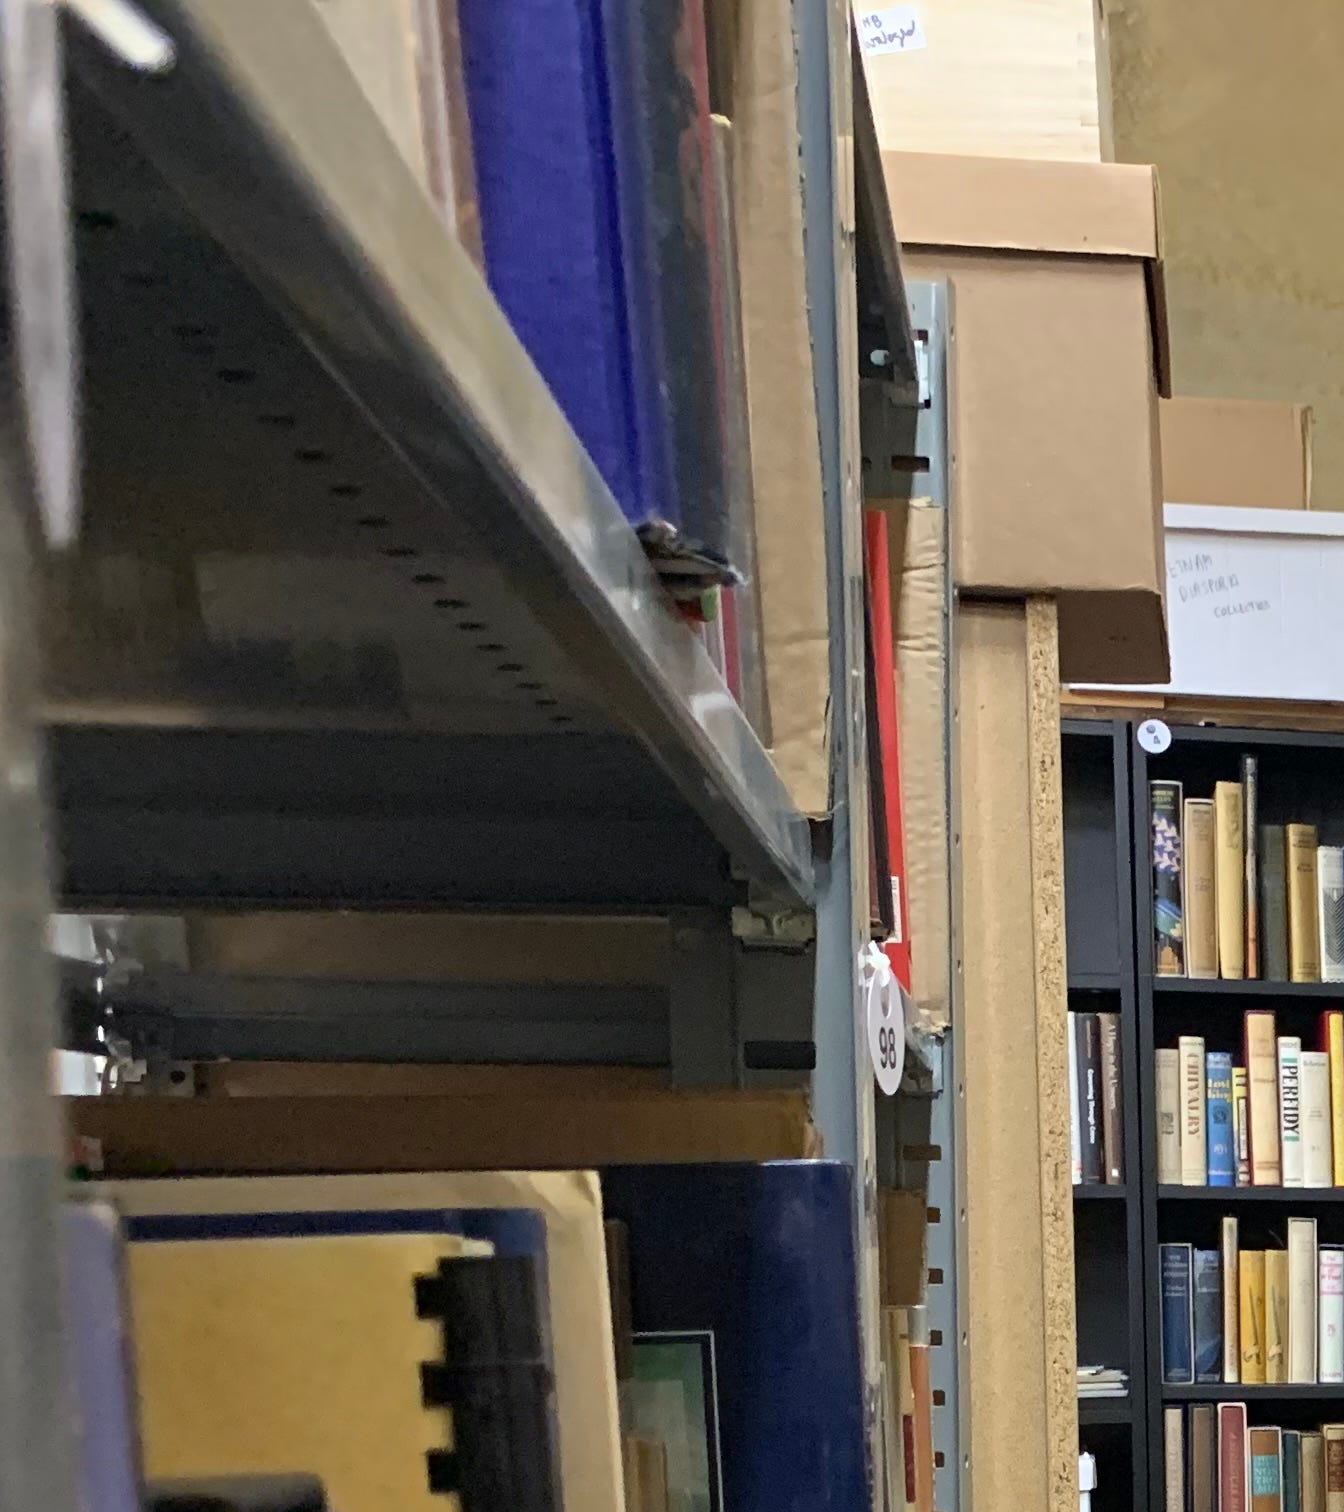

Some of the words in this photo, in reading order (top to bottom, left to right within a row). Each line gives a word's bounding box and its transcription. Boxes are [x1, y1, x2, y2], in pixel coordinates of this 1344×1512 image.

[878, 1025, 897, 1070] 98
[1186, 1053, 1201, 1138] CHIVALRY
[1282, 1064, 1300, 1137] PERFIDY
